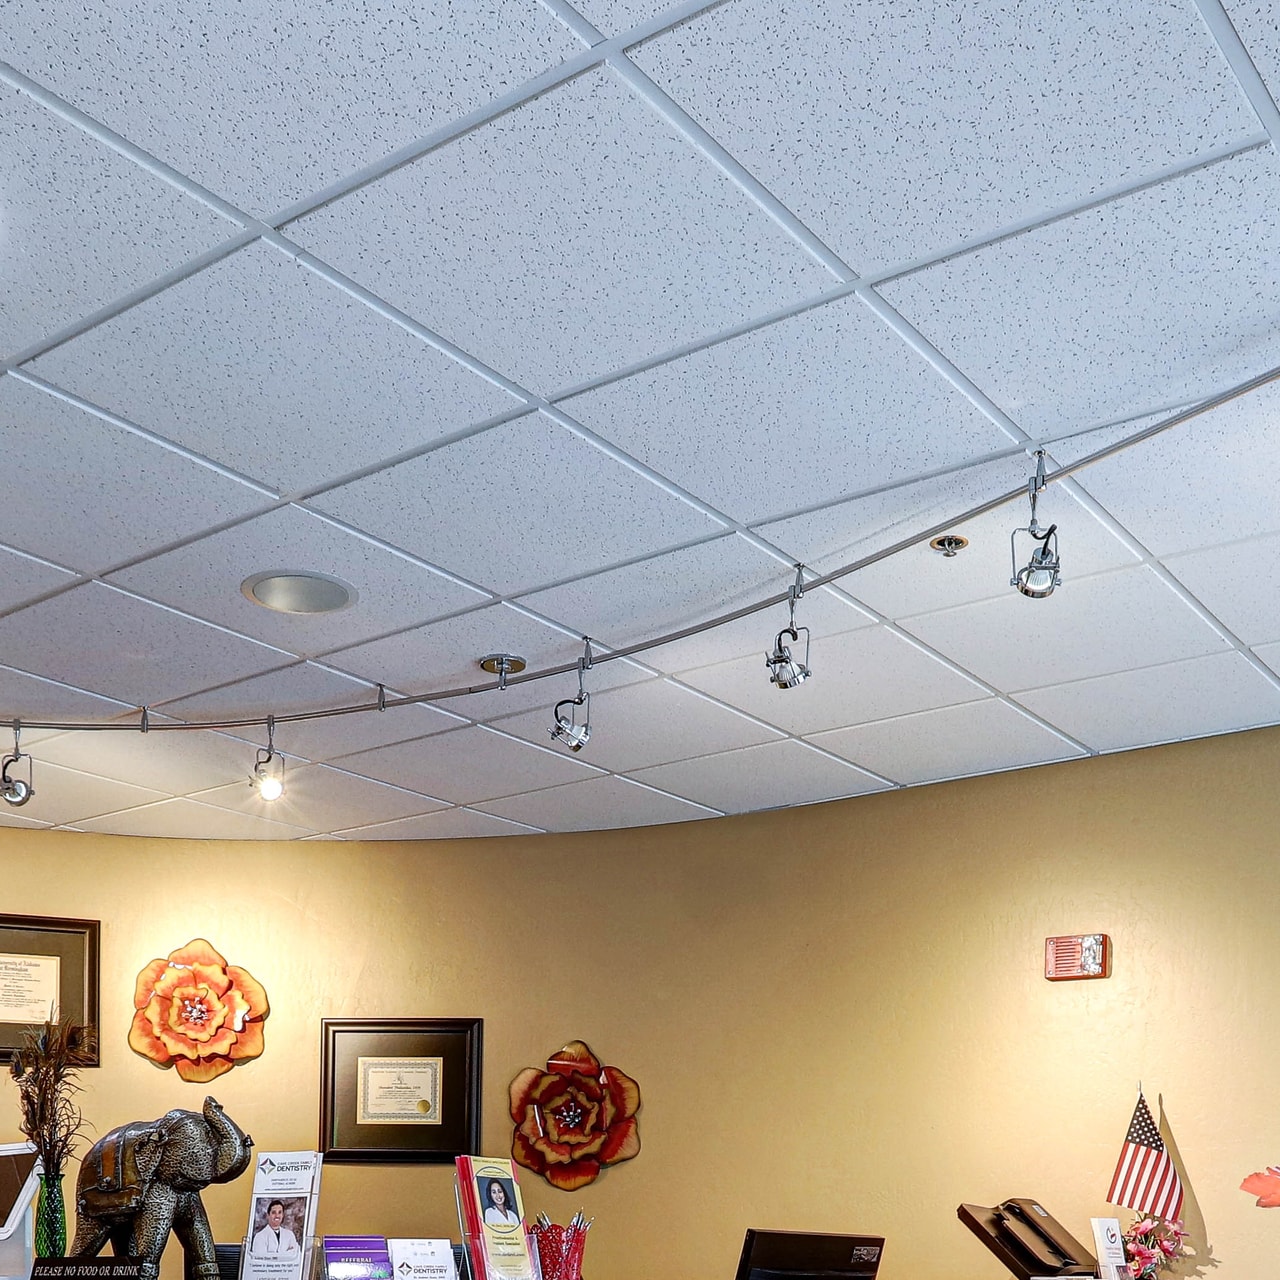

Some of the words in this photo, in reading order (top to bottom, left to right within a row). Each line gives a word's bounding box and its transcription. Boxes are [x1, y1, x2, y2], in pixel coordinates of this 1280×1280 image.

[34, 1266, 63, 1276] PLEASE
[64, 1266, 76, 1276] NO
[77, 1266, 98, 1276] FOOD
[99, 1266, 111, 1276] OR
[112, 1265, 140, 1276] DRINK
